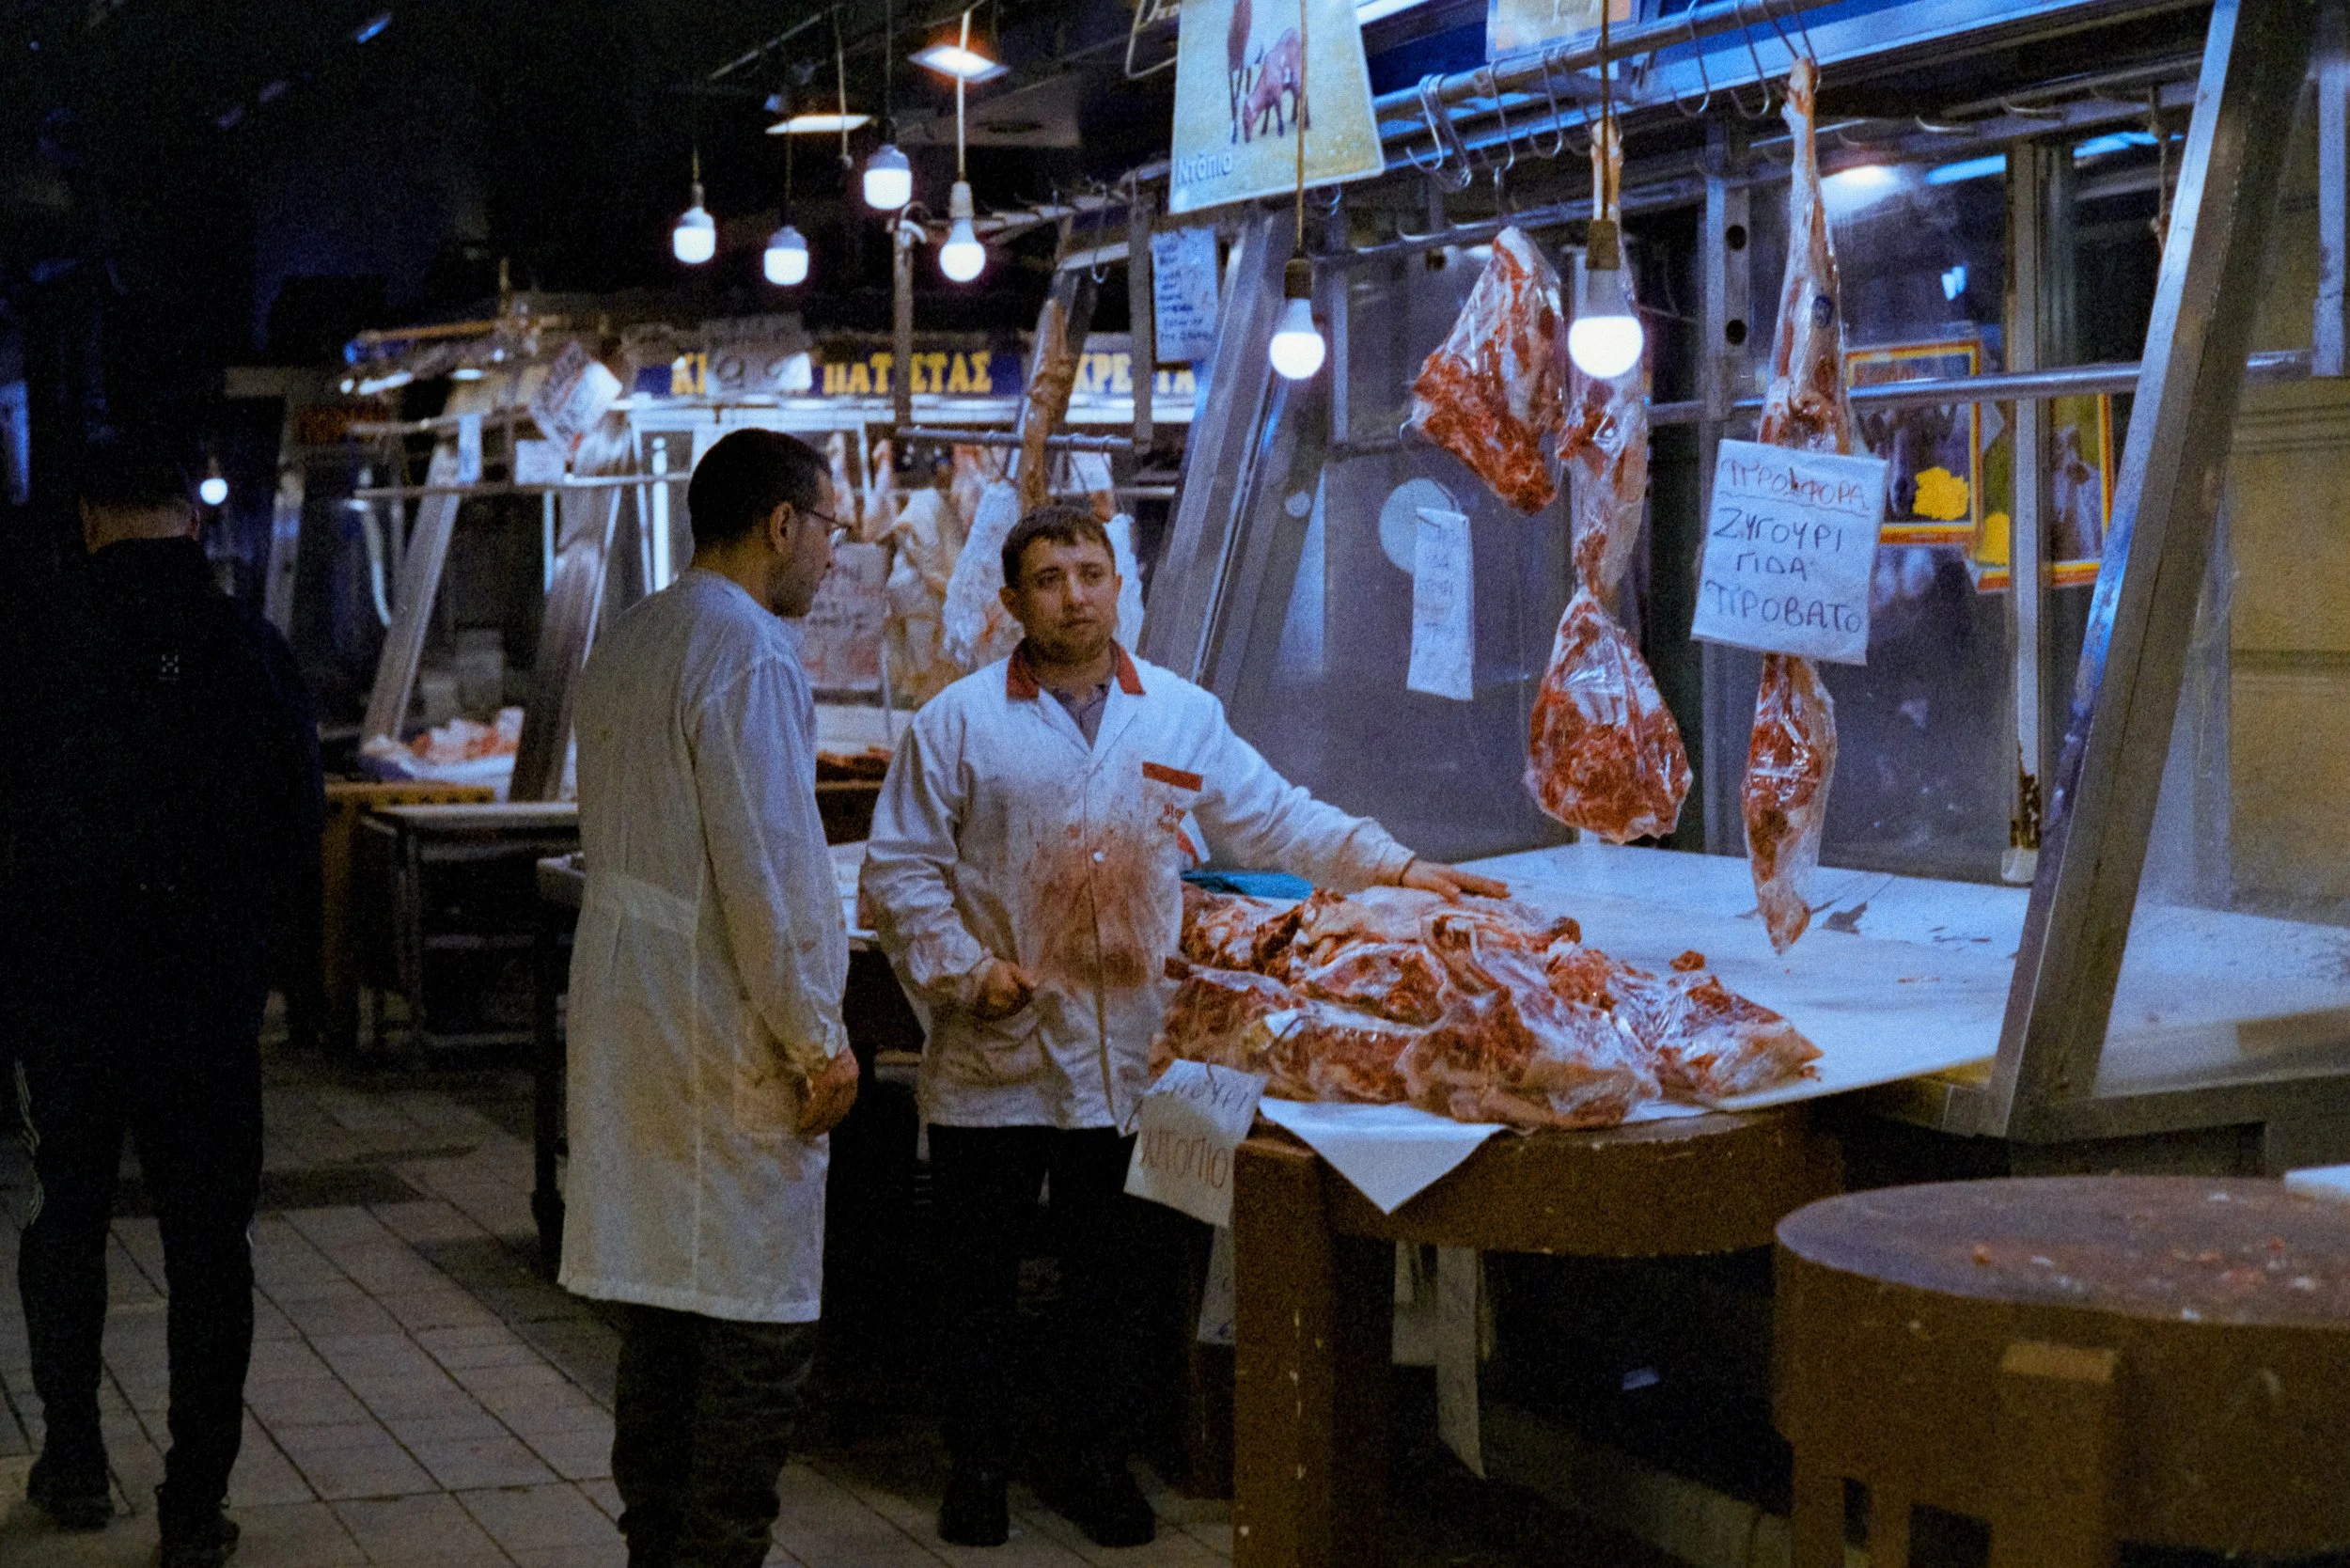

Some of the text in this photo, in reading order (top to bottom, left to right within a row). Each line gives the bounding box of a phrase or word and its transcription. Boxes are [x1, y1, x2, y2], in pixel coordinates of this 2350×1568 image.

[1713, 507, 1842, 553] ΖΥΓΟΥΡΙ
[1736, 552, 1808, 582] ΓΙΔΑ
[1704, 579, 1862, 634] ΠΡΟΒΑΤΟ
